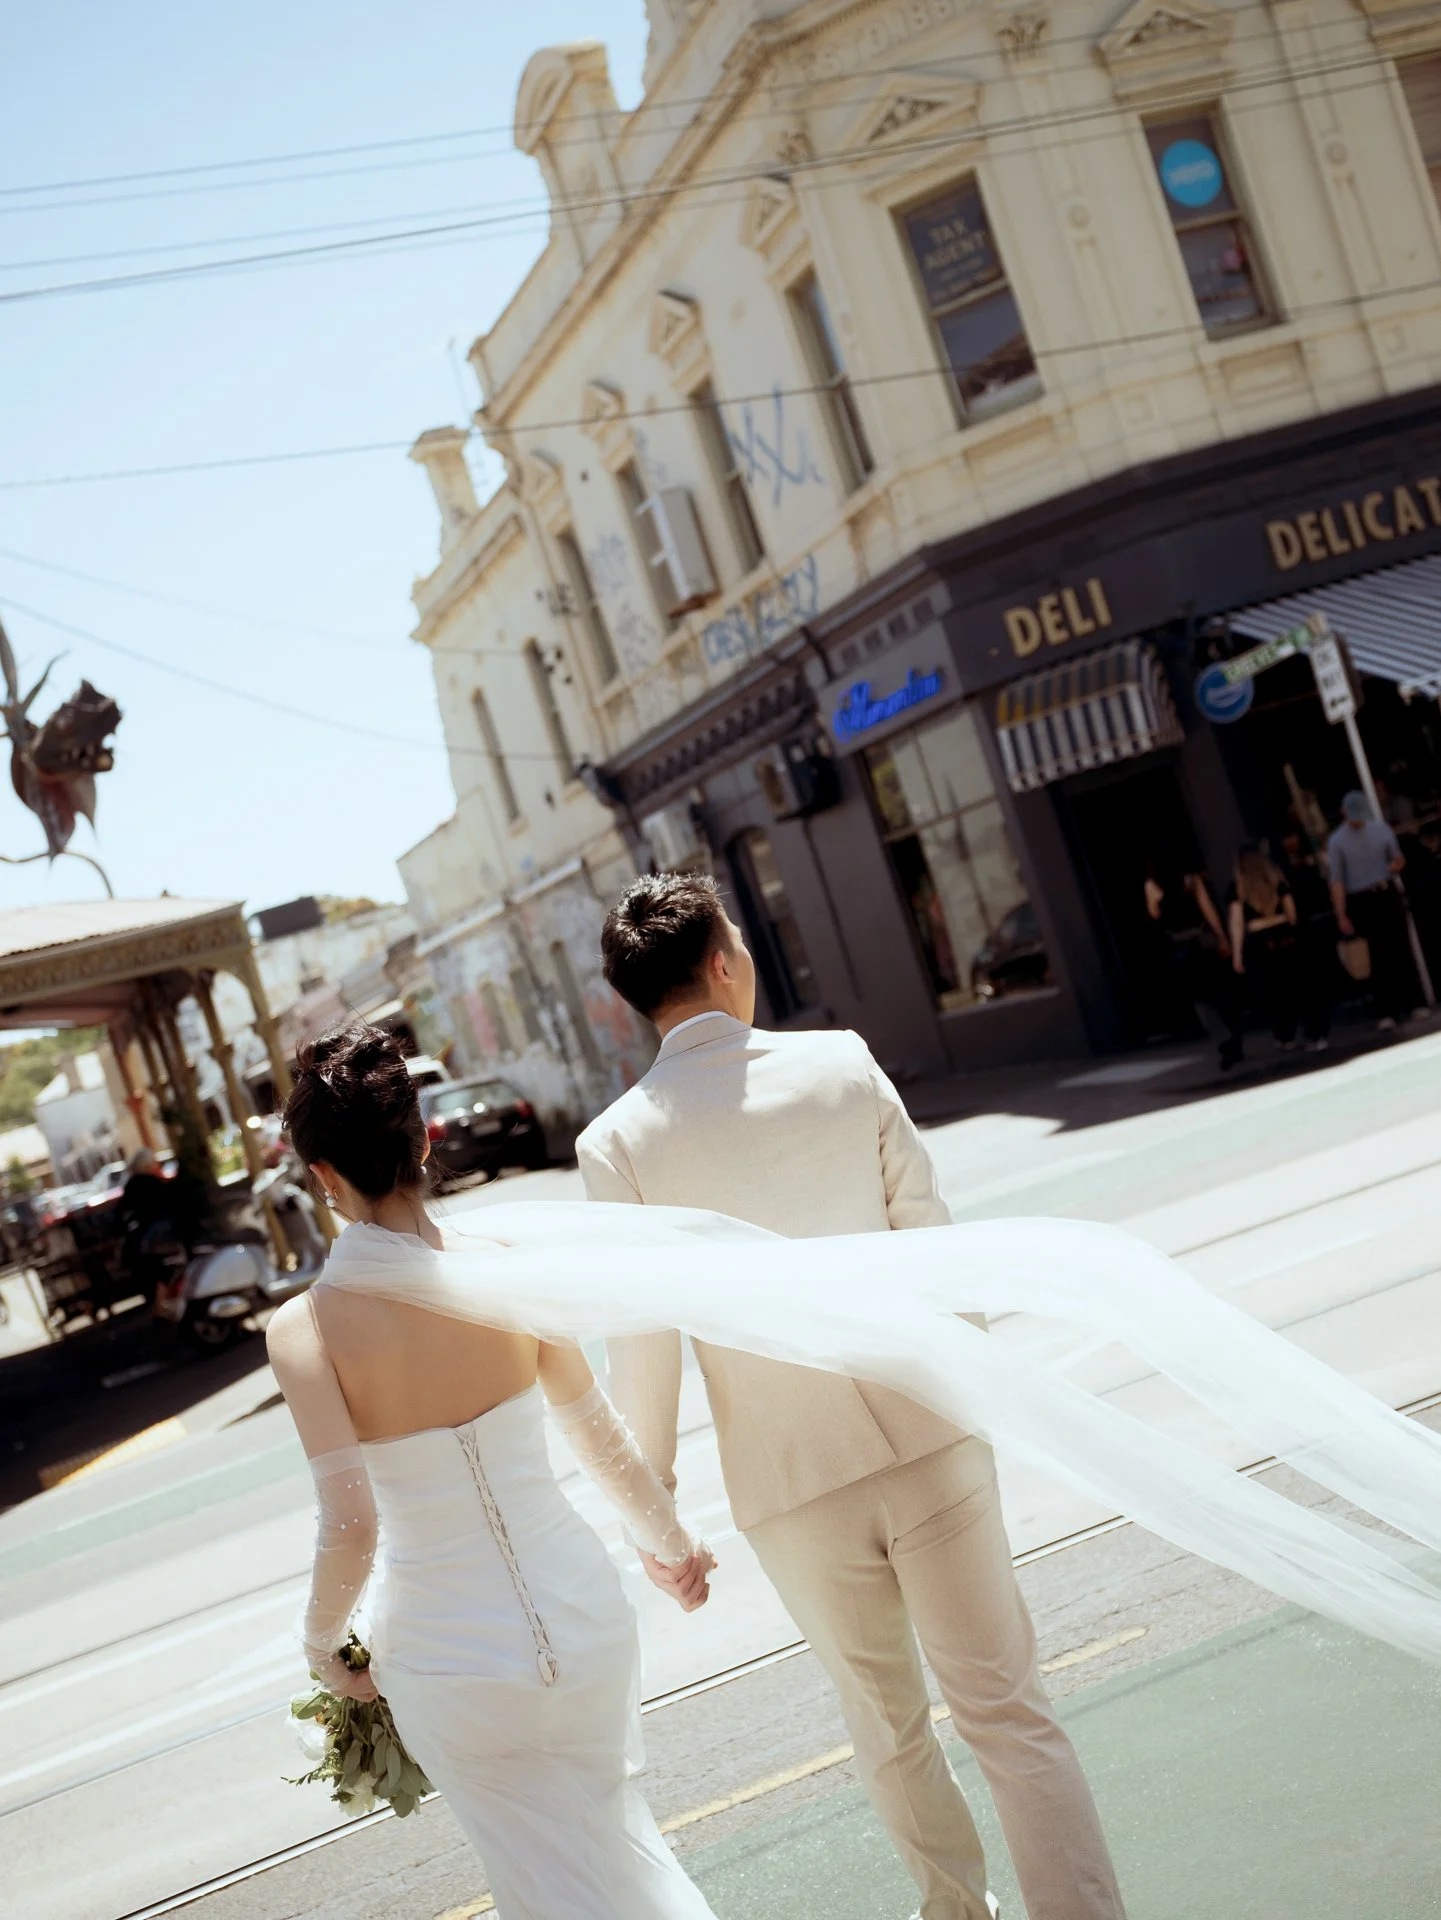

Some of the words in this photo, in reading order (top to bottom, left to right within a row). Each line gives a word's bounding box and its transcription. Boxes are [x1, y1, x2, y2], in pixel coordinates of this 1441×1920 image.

[923, 228, 985, 270] AGENT
[928, 217, 968, 246] TAX
[1266, 477, 1441, 571] DELICAT
[1003, 577, 1112, 658] DELI
